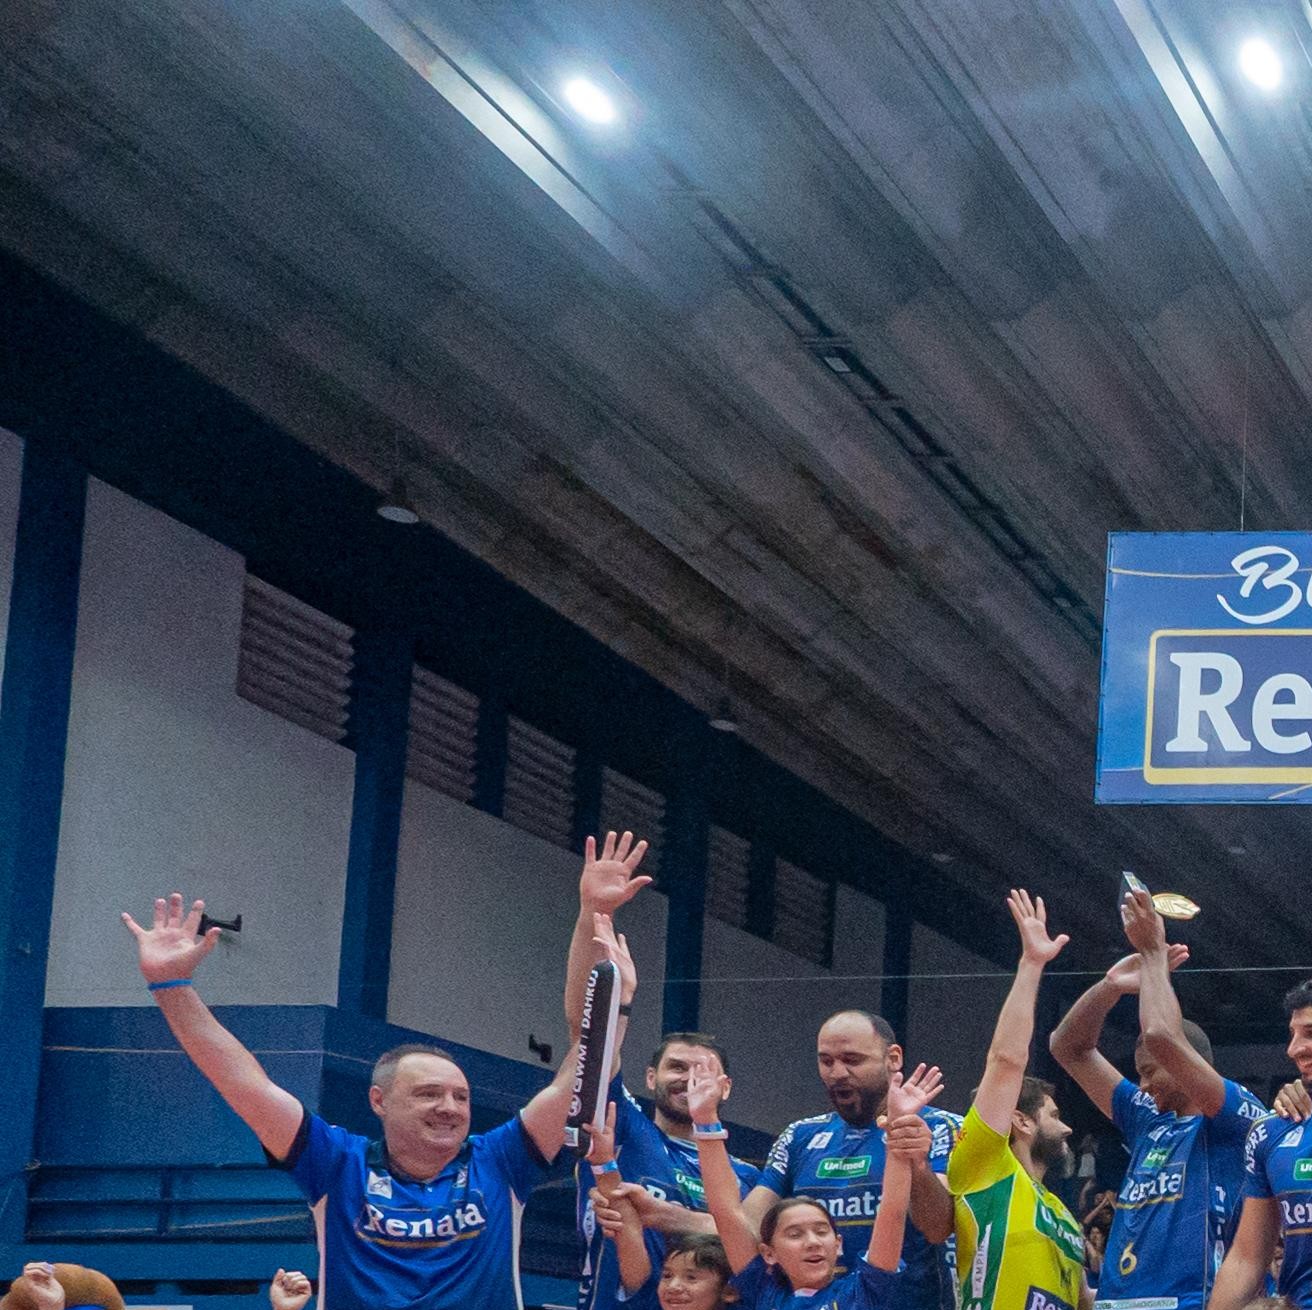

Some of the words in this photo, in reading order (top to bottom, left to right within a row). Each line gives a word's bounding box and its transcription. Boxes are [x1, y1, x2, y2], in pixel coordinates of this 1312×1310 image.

[824, 1159, 866, 1171] Unimed
[363, 1202, 486, 1238] Renata
[1119, 1241, 1138, 1277] 6
